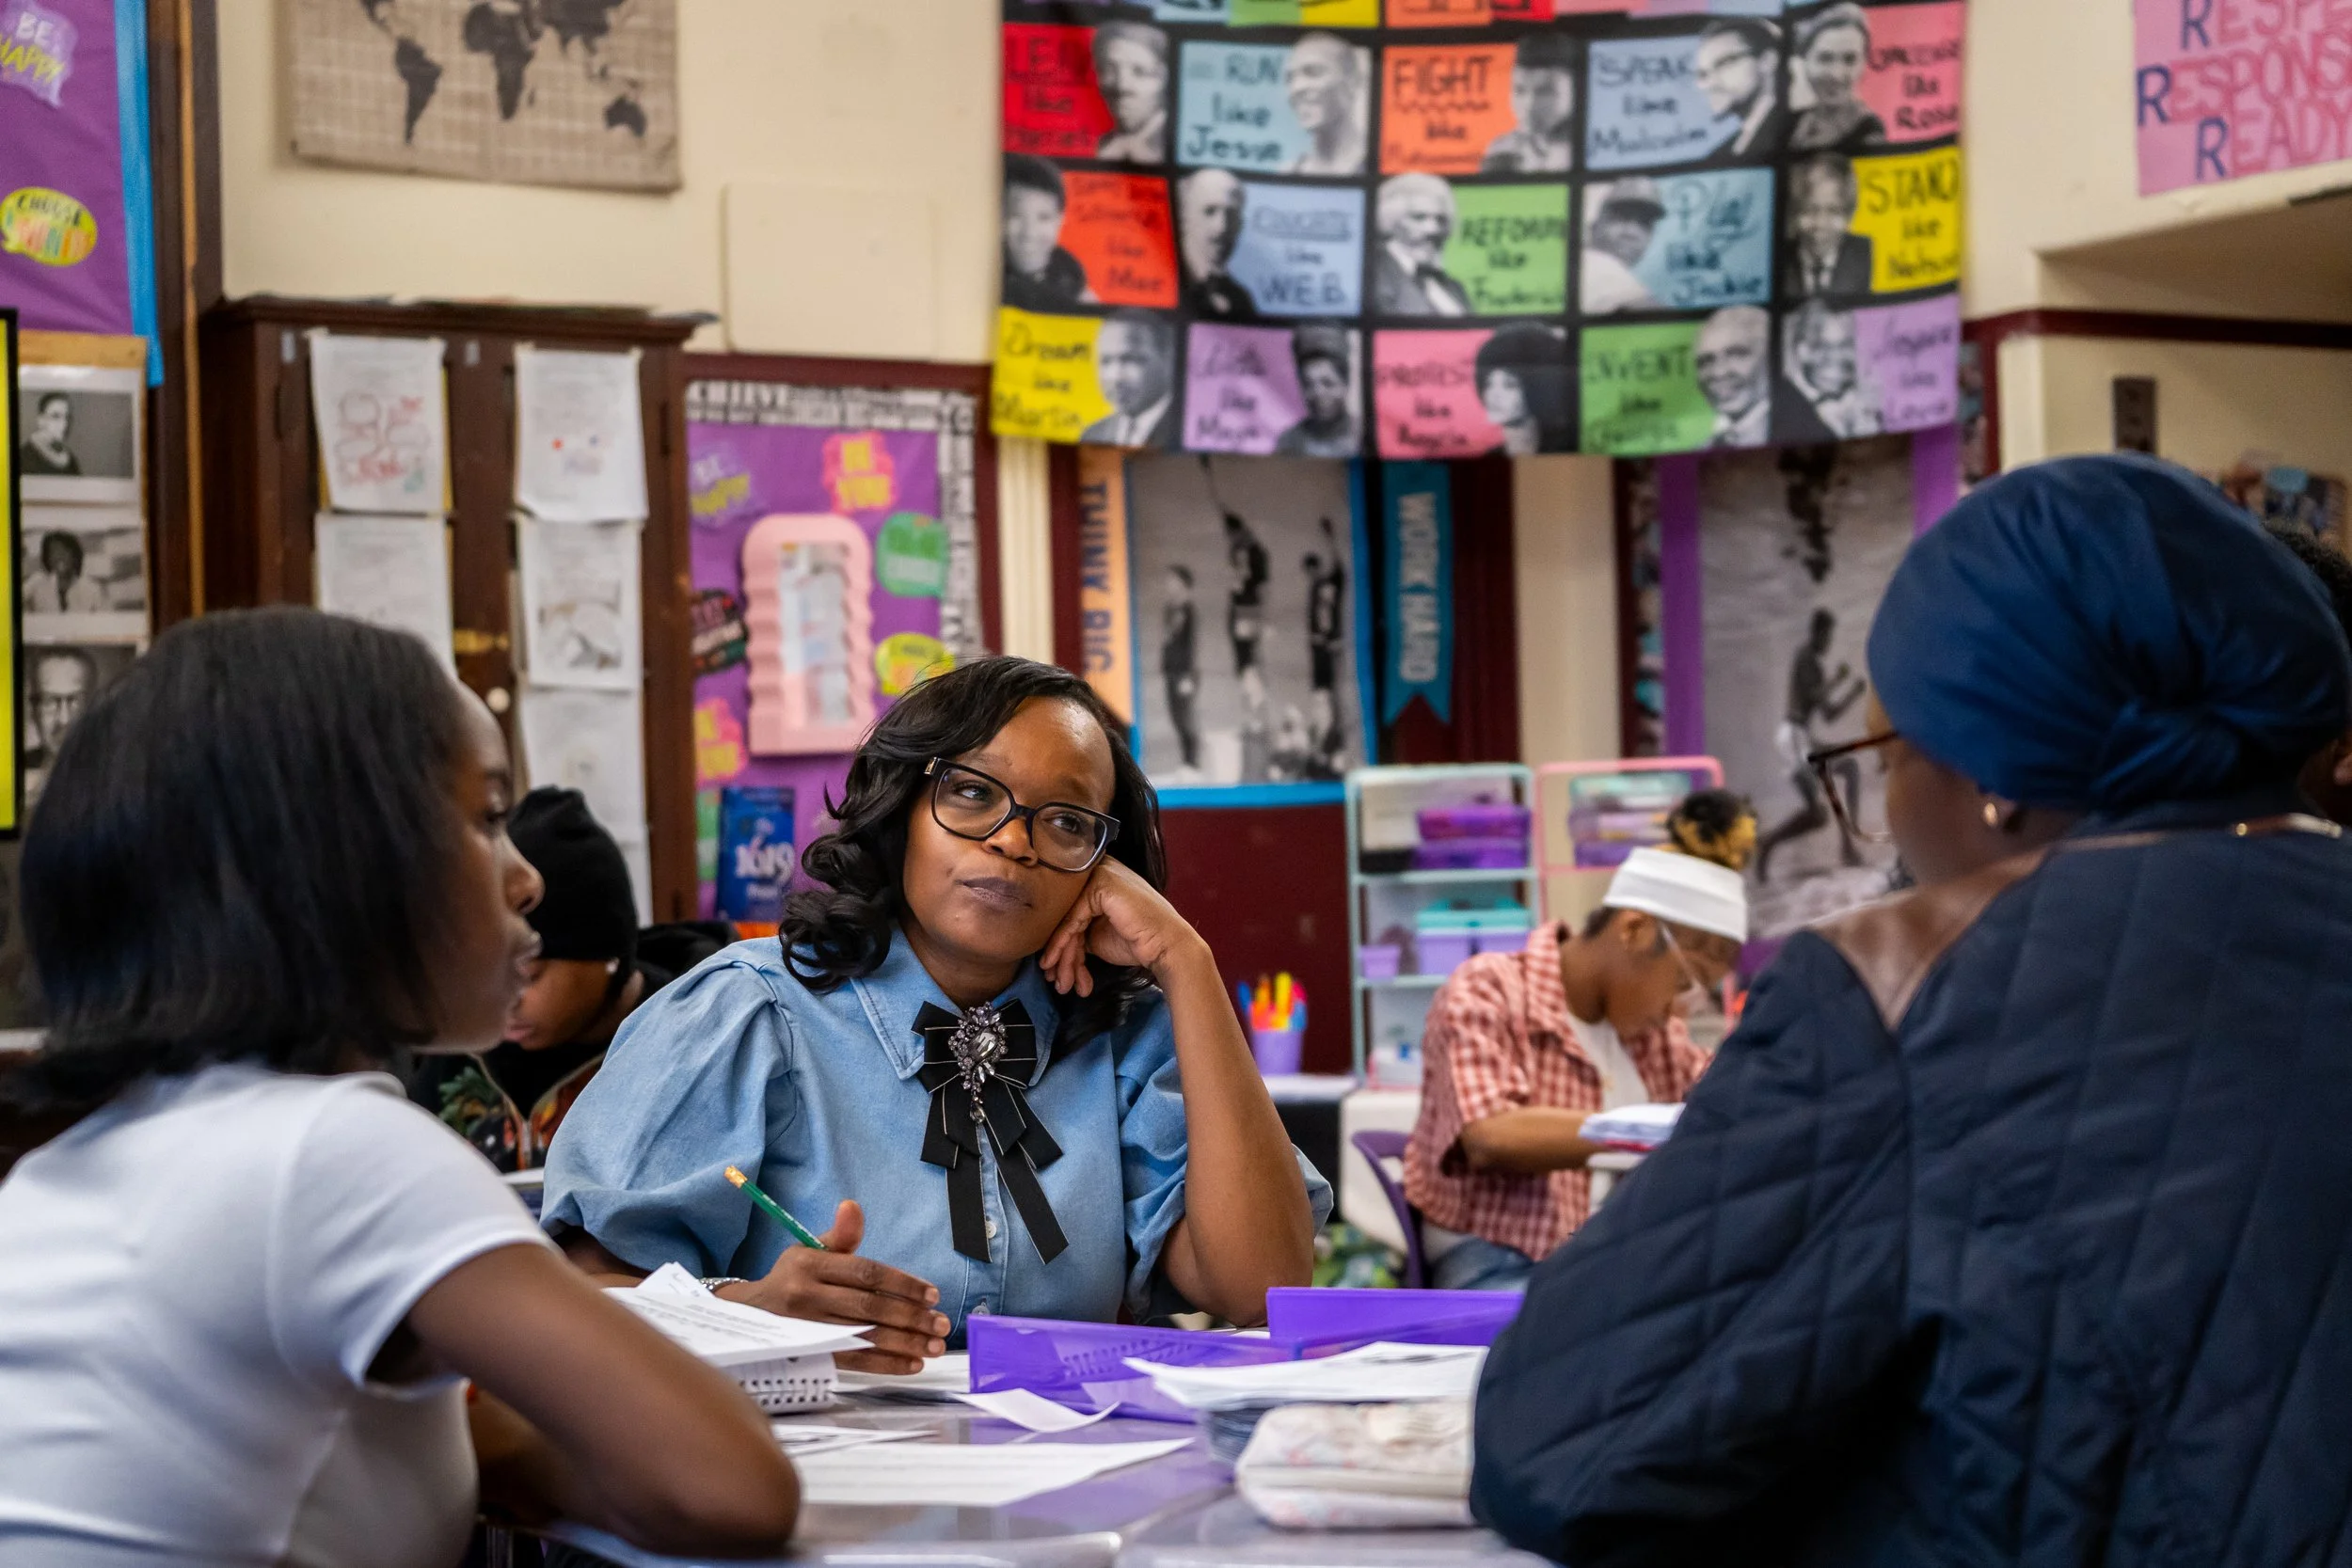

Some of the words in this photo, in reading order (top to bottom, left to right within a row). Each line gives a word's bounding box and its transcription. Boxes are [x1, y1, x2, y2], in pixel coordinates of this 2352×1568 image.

[1393, 55, 1493, 96] FIGHT
[1214, 92, 1272, 127] like
[736, 834, 795, 887] 1619
